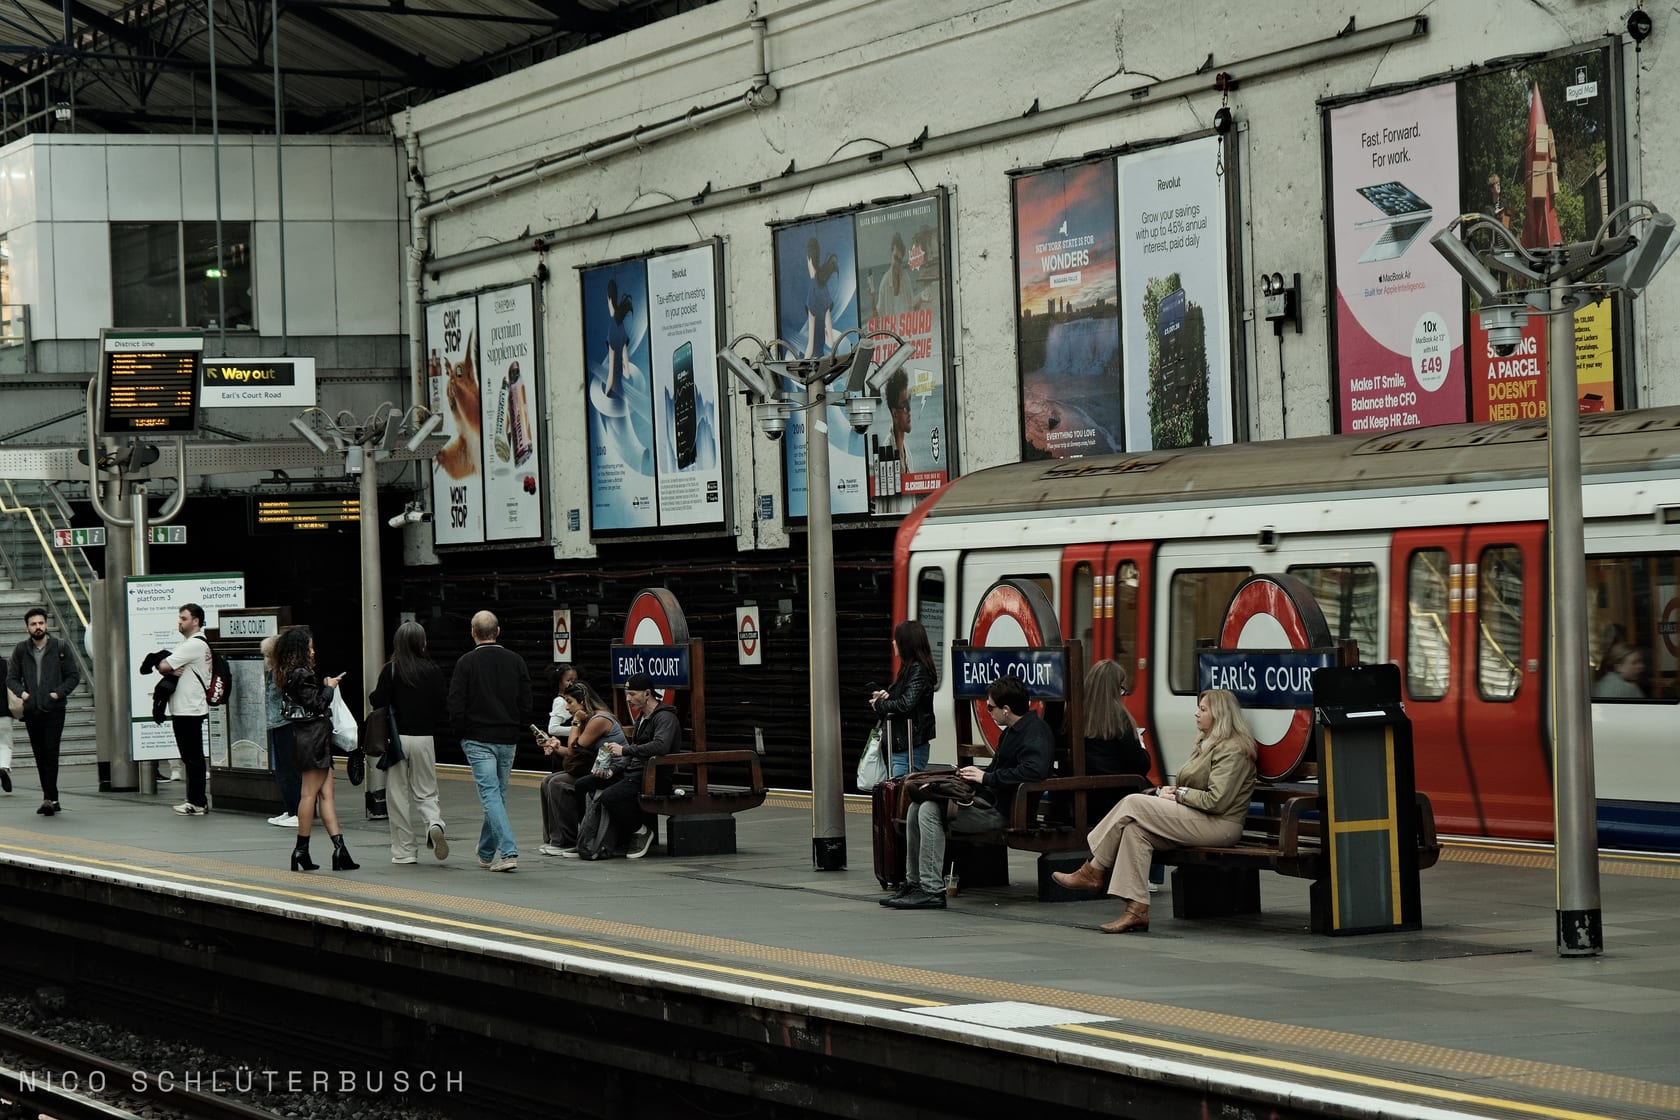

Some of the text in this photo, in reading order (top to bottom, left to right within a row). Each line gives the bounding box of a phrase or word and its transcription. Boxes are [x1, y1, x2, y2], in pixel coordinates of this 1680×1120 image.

[1568, 85, 1596, 98] Royal Mail
[1361, 122, 1421, 148] Fast. Forward.
[1372, 147, 1411, 168] For work.
[1157, 176, 1181, 191] Revolut
[1142, 204, 1200, 224] Grow your savings
[1136, 227, 1150, 240] with
[1150, 228, 1158, 240] up
[1160, 226, 1166, 236] to
[1186, 216, 1208, 232] annual
[1036, 235, 1094, 254] NEW YORK STATE IS FOR
[1144, 233, 1200, 254] interest, paid daily
[1040, 249, 1090, 272] WONDERS
[672, 268, 688, 280] Revolut
[1382, 272, 1404, 282] MacBook
[1364, 288, 1376, 297] Built
[1384, 286, 1398, 295] Apple
[444, 309, 460, 329] CAN'T
[899, 308, 932, 338] SQUAD
[1422, 320, 1438, 333] 10x
[444, 329, 462, 354] STOP
[491, 320, 522, 345] premium
[1416, 336, 1432, 344] MacBook
[486, 342, 528, 366] supplements
[221, 368, 276, 382] Way out
[1421, 356, 1442, 374] £49
[1488, 358, 1540, 380] A PARCEL
[1350, 372, 1406, 392] Make IT Smile,
[1488, 380, 1538, 400] DOESN'T
[1352, 392, 1416, 412] Balance the CFO
[1489, 402, 1519, 422] NEED
[1520, 401, 1534, 419] TO
[1352, 412, 1420, 430] and Keep HR Zen.
[1046, 428, 1096, 440] EVERYTHING YOU LOVE
[450, 486, 468, 504] WON'T
[450, 505, 468, 528] STOP
[200, 584, 236, 592] Westbound
[202, 592, 230, 600] platform
[230, 620, 266, 634] EARLS COURT
[618, 654, 680, 676] EARL'S COURT
[964, 658, 1052, 685] EARL'S COURT
[1211, 662, 1256, 691] EARL'S
